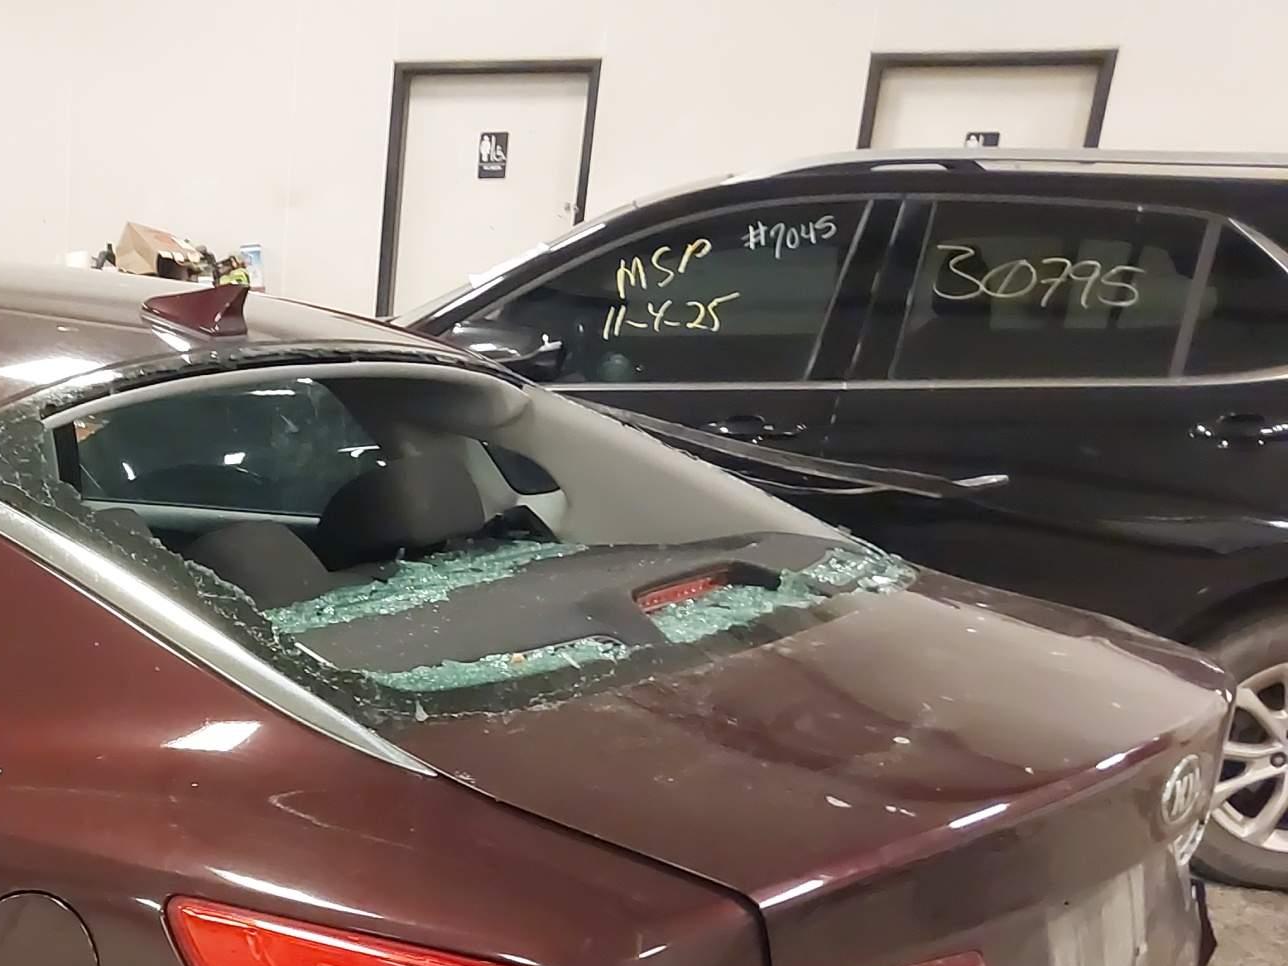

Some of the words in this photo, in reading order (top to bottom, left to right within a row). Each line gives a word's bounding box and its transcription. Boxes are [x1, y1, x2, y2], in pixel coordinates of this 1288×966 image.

[741, 215, 837, 259] #7045
[616, 238, 712, 299] MSP
[933, 244, 1145, 309] 30795
